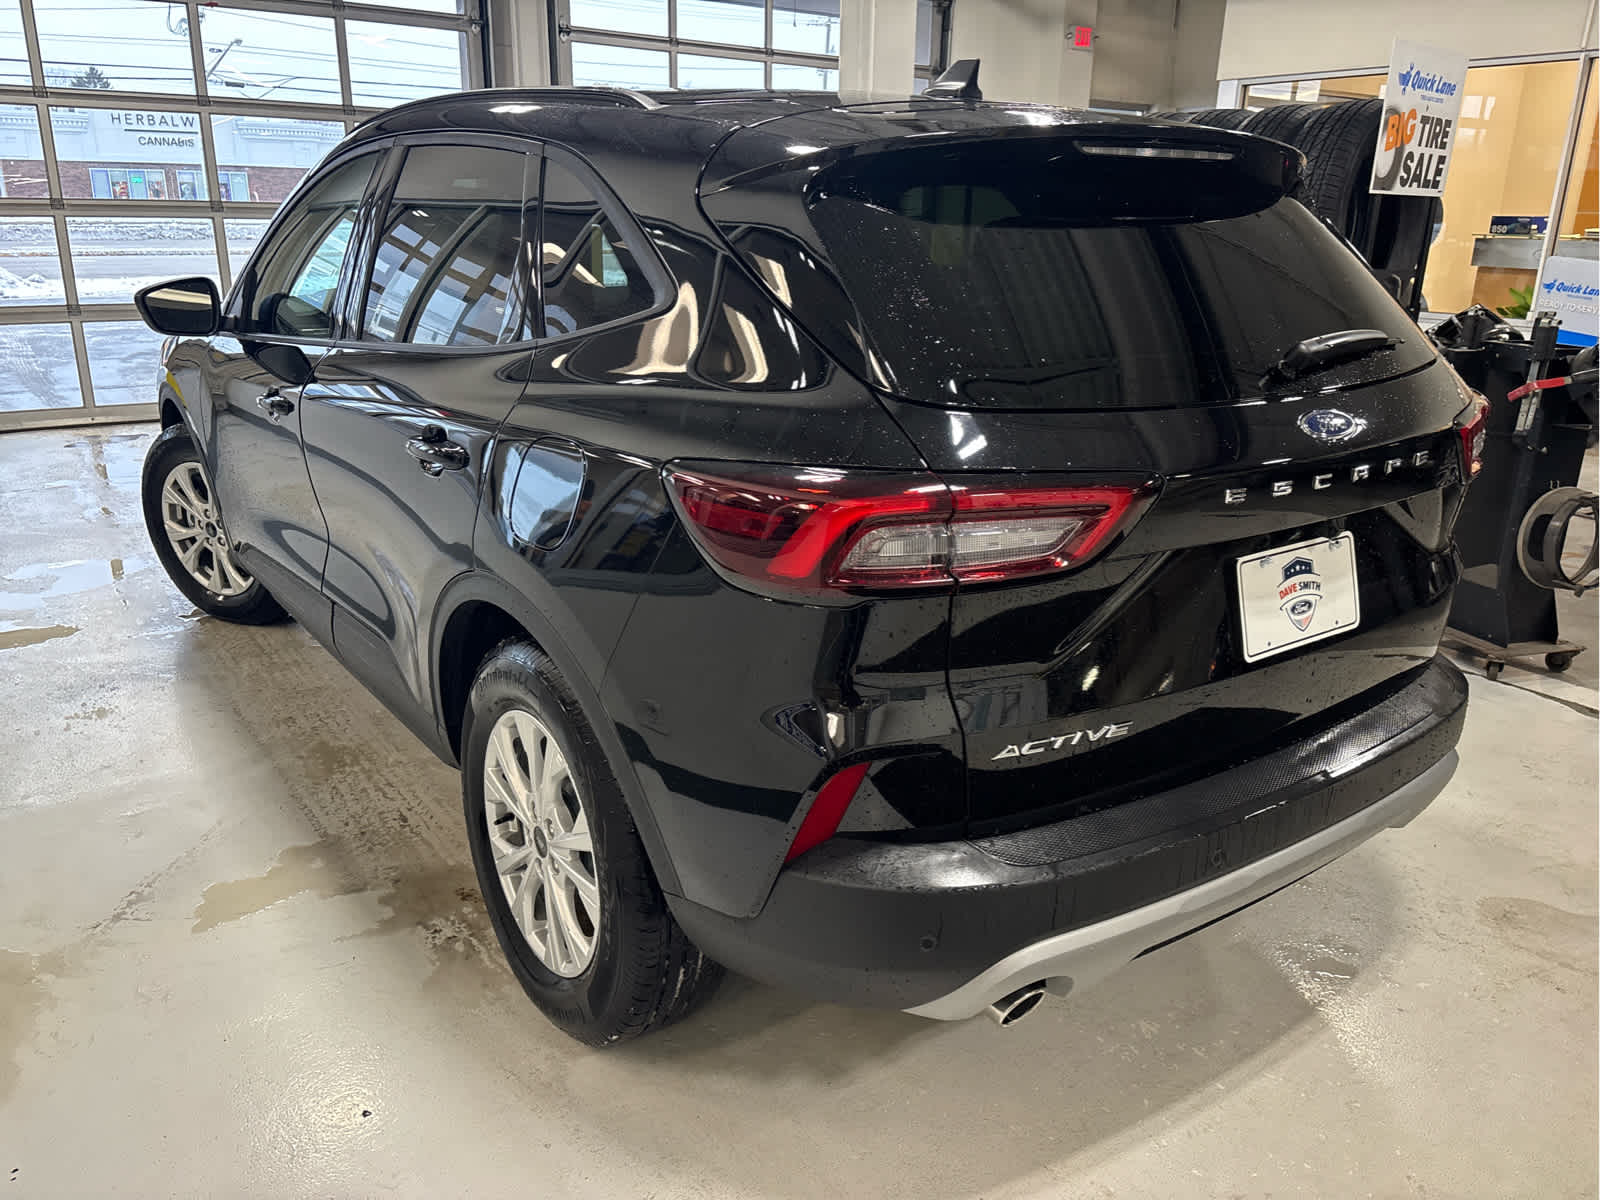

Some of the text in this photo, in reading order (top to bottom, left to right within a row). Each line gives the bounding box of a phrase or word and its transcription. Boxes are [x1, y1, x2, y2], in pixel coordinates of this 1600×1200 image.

[1411, 70, 1457, 96] Quick Lane
[138, 136, 195, 148] CANNABIS
[1384, 108, 1452, 152] BIG TIRE
[1400, 151, 1447, 189] SALE
[1556, 281, 1582, 293] Quick
[1224, 450, 1430, 505] ESCAPE
[1279, 581, 1321, 600] DAVE SMITH
[991, 721, 1134, 761] ACTIVE
